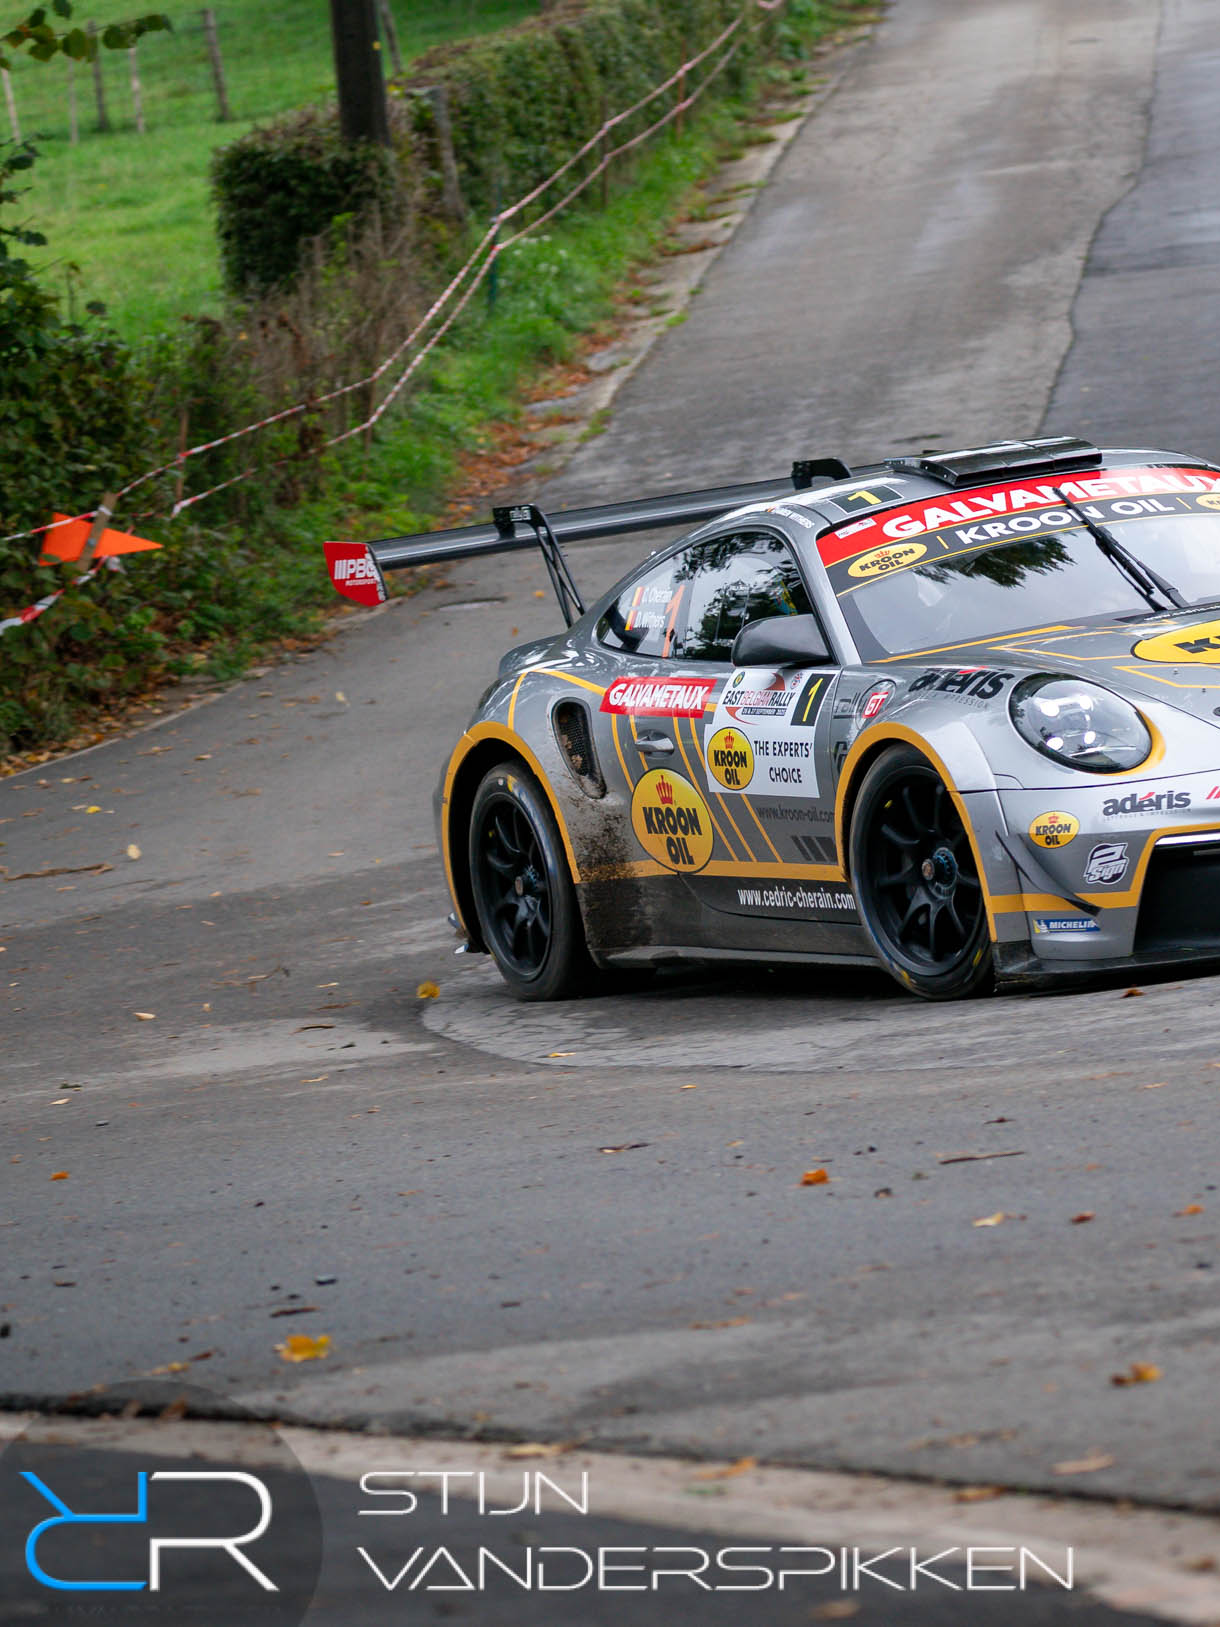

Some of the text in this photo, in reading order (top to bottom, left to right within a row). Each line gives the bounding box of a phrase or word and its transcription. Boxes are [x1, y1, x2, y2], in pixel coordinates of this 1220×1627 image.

[847, 489, 882, 505] 1
[955, 497, 1175, 546] KROON OIL
[858, 548, 916, 572] KROON
[878, 559, 904, 572] OIL
[661, 584, 687, 659] 1
[609, 682, 711, 710] GALVAMETAUX
[801, 678, 824, 722] 1
[864, 692, 889, 717] GT
[713, 750, 748, 768] KROON
[754, 739, 813, 758] THE EXPERTS'
[724, 768, 741, 786] OIL
[769, 767, 803, 784] CHOICE
[1102, 790, 1192, 817] adéris
[641, 806, 703, 836] KROON
[1034, 822, 1072, 836] KROON
[665, 836, 696, 866] OIL
[1044, 834, 1061, 846] OIL
[737, 885, 856, 910] www.cedric-cherain.com
[1049, 912, 1096, 930] MICHELIN
